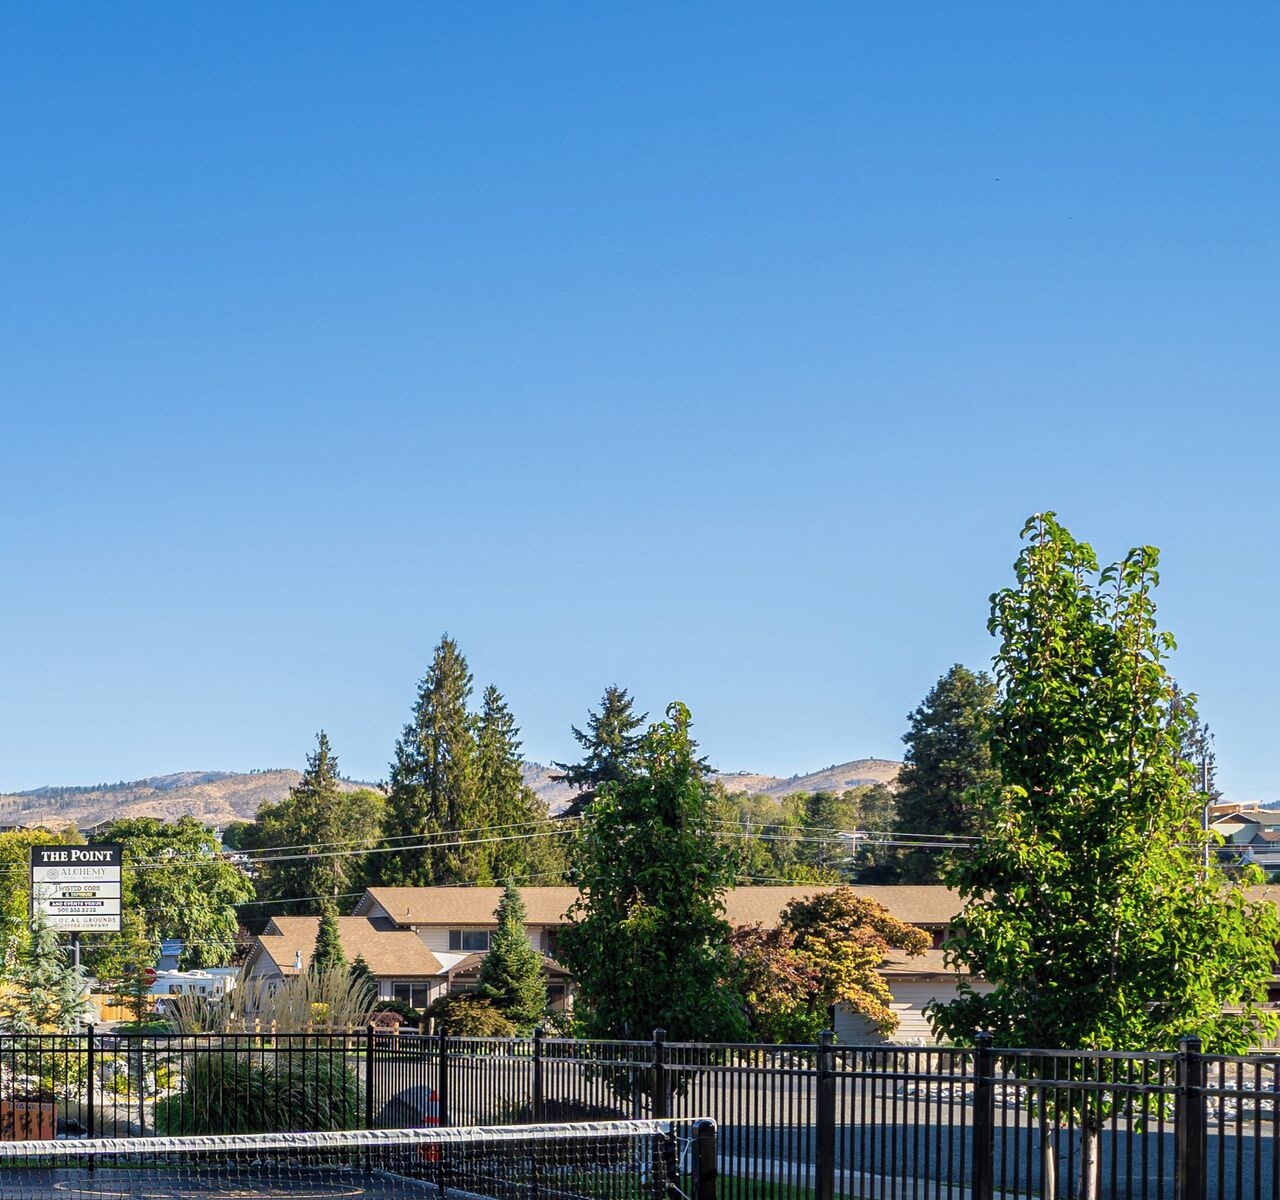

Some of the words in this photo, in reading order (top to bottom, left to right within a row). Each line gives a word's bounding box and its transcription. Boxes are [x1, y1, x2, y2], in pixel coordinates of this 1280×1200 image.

[41, 851, 68, 861] THE
[71, 849, 113, 861] POINT
[61, 868, 106, 876] ALCHEMY
